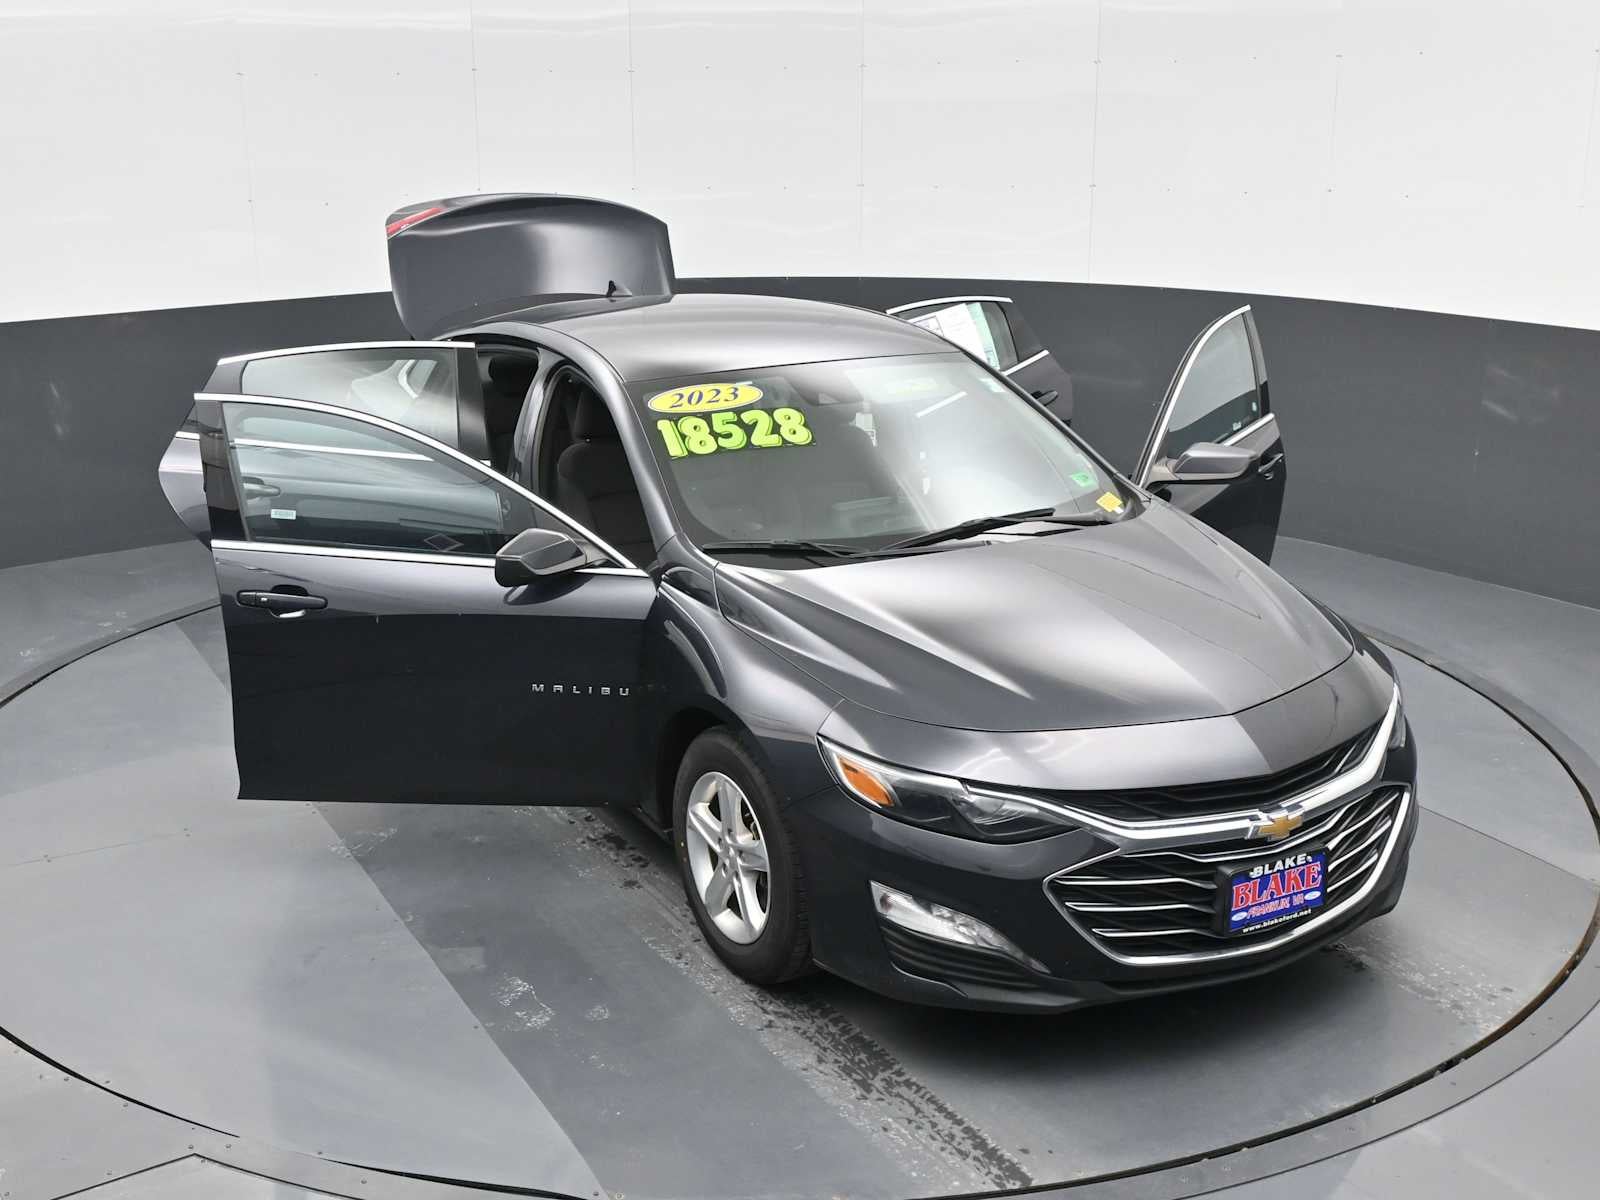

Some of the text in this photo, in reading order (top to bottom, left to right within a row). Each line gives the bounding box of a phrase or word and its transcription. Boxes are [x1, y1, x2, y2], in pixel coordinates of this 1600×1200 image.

[669, 387, 739, 408] 2023
[657, 407, 812, 457] 18528
[531, 684, 630, 696] MALIBU
[1232, 862, 1322, 911] BLAKE
[1242, 908, 1312, 933] www.blakeford.net
